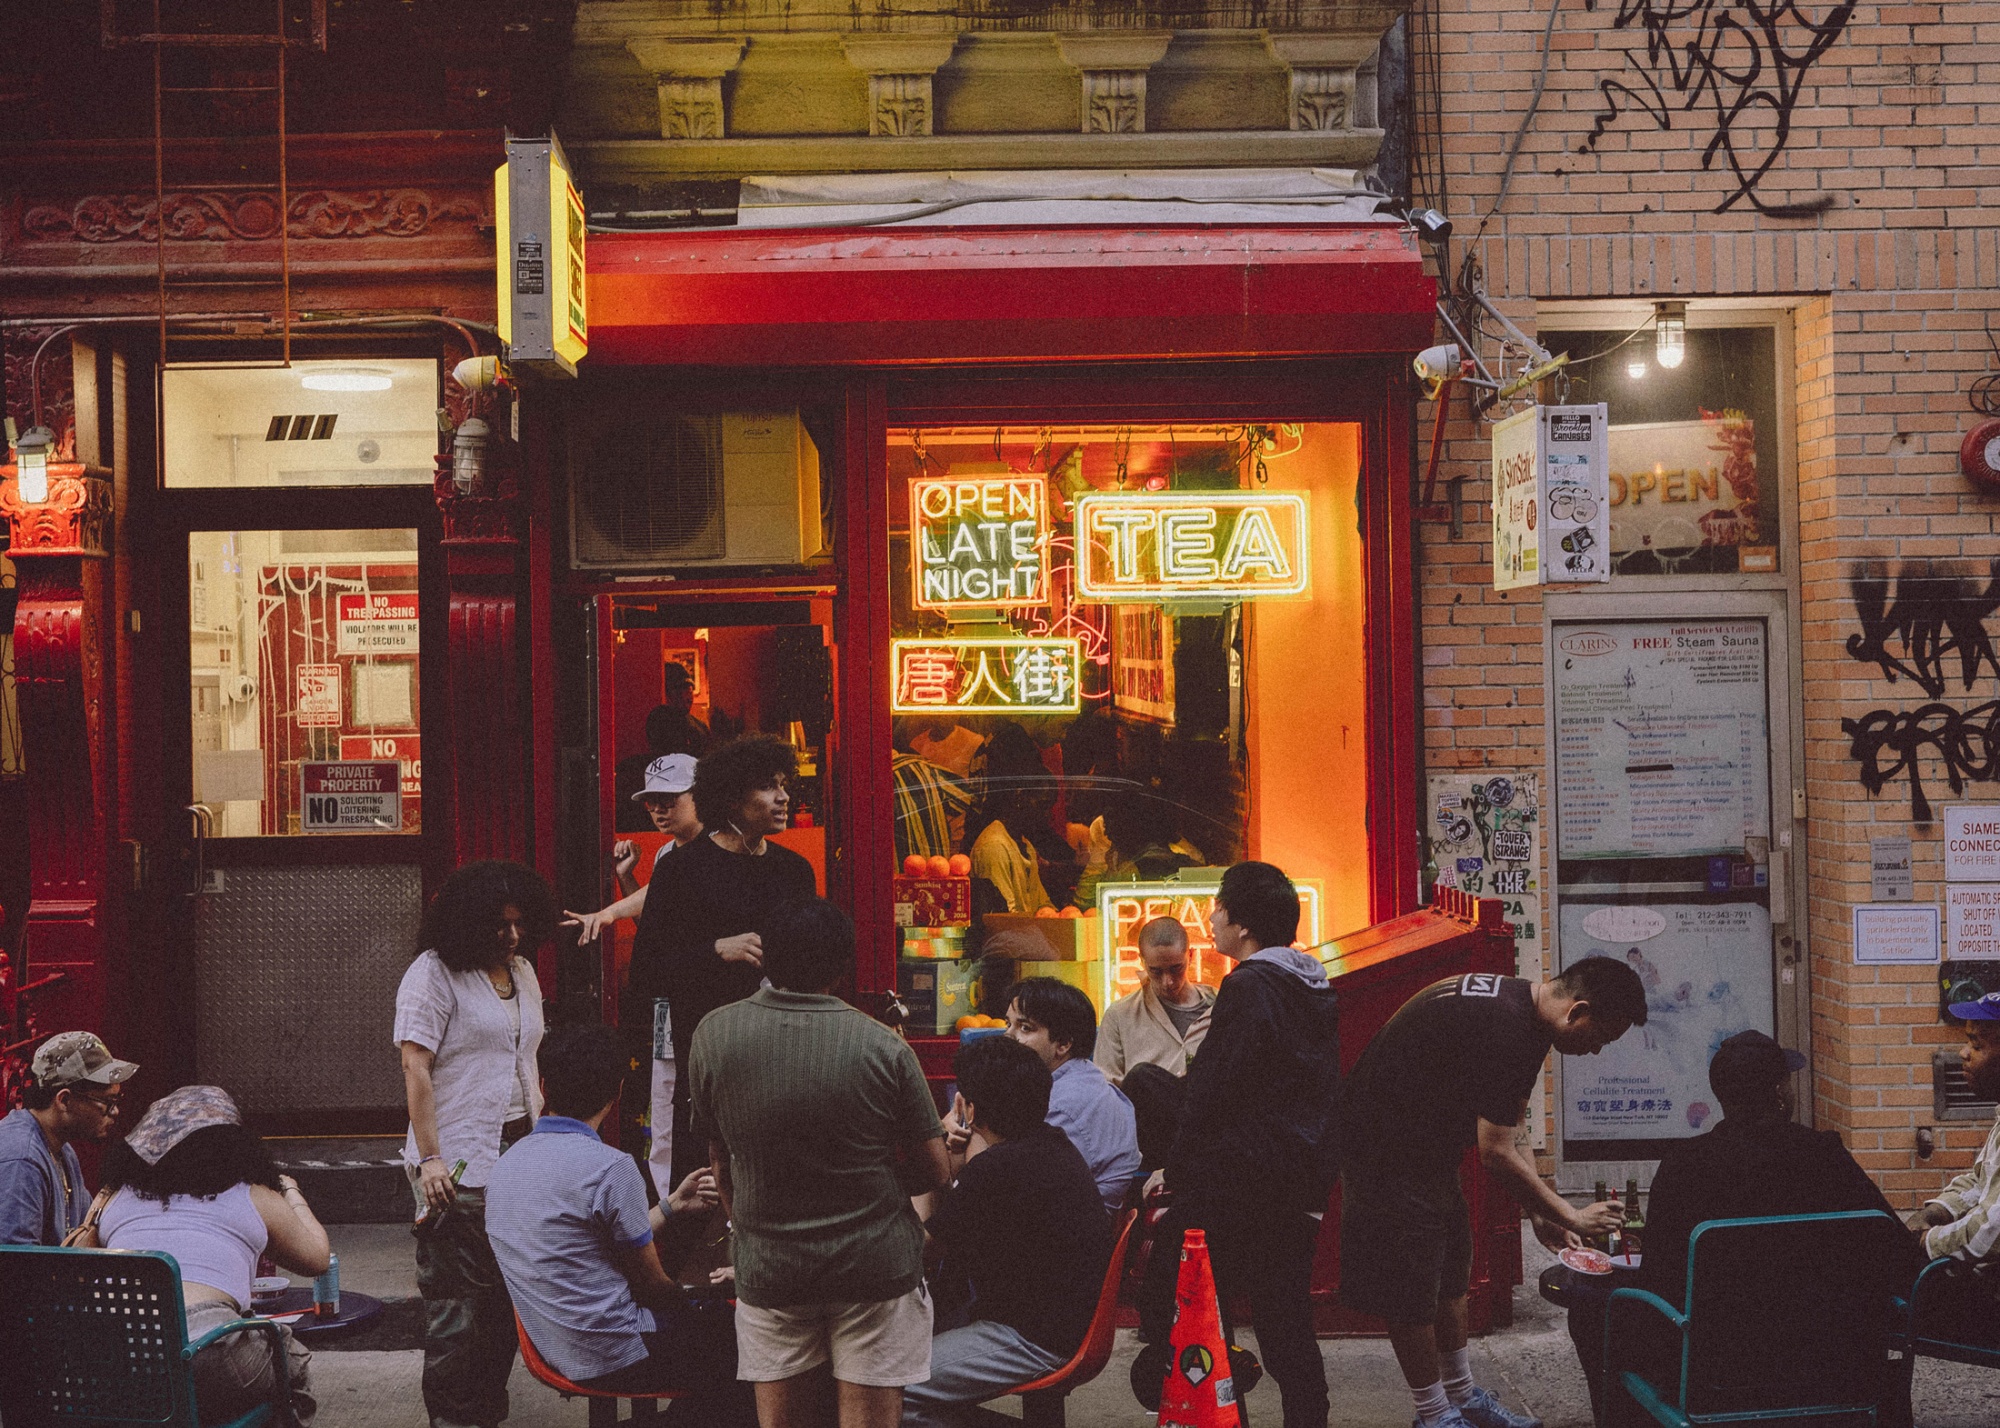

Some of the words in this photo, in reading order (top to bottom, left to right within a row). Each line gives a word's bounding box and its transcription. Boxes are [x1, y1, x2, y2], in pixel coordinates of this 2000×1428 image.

[1609, 466, 1718, 507] OPEN
[921, 483, 1036, 518] OPEN
[921, 519, 1040, 563] LATE
[1090, 506, 1293, 582] TEA
[922, 565, 1040, 600] NIGHT
[374, 597, 389, 608] NO
[347, 607, 416, 620] TRESPASSING
[388, 623, 405, 633] WILL
[407, 623, 418, 633] BE
[1560, 638, 1618, 649] CLARINS
[1632, 637, 1672, 650] FREE
[1676, 637, 1715, 649] Steam
[1721, 636, 1760, 647] Sauna
[902, 647, 1068, 705] 唐人街
[1596, 697, 1631, 705] Treatment
[372, 739, 397, 757] NO
[327, 766, 376, 778] PRIVATE
[320, 778, 384, 792] PROPERTY
[309, 796, 339, 825] NO
[340, 795, 385, 805] SOLICITING
[340, 805, 382, 814] LOITERING
[340, 813, 395, 824] TRESPASSING
[1962, 823, 2000, 835] SIAME
[1950, 840, 2000, 851] CONNEC
[1954, 855, 1974, 865] FOR
[1976, 855, 1996, 865] FIRE
[1497, 871, 1523, 882] IVE
[914, 881, 941, 889] Sunkist
[1495, 882, 1524, 893] THK
[1952, 892, 1991, 904] AUTOMATIC
[1963, 908, 1983, 920] SHUT
[1984, 908, 1996, 920] OFF
[1864, 915, 1896, 925] building
[1911, 925, 1928, 935] only
[1959, 924, 1992, 936] LOCATED
[1866, 936, 1874, 944] in
[1875, 936, 1911, 944] basement
[1913, 936, 1928, 944] and
[1881, 946, 1894, 955] 1st
[1894, 946, 1914, 955] floor
[1958, 940, 1992, 952] OPPOSITE
[1598, 1075, 1650, 1084] Professional
[1621, 1086, 1665, 1096] Treatment
